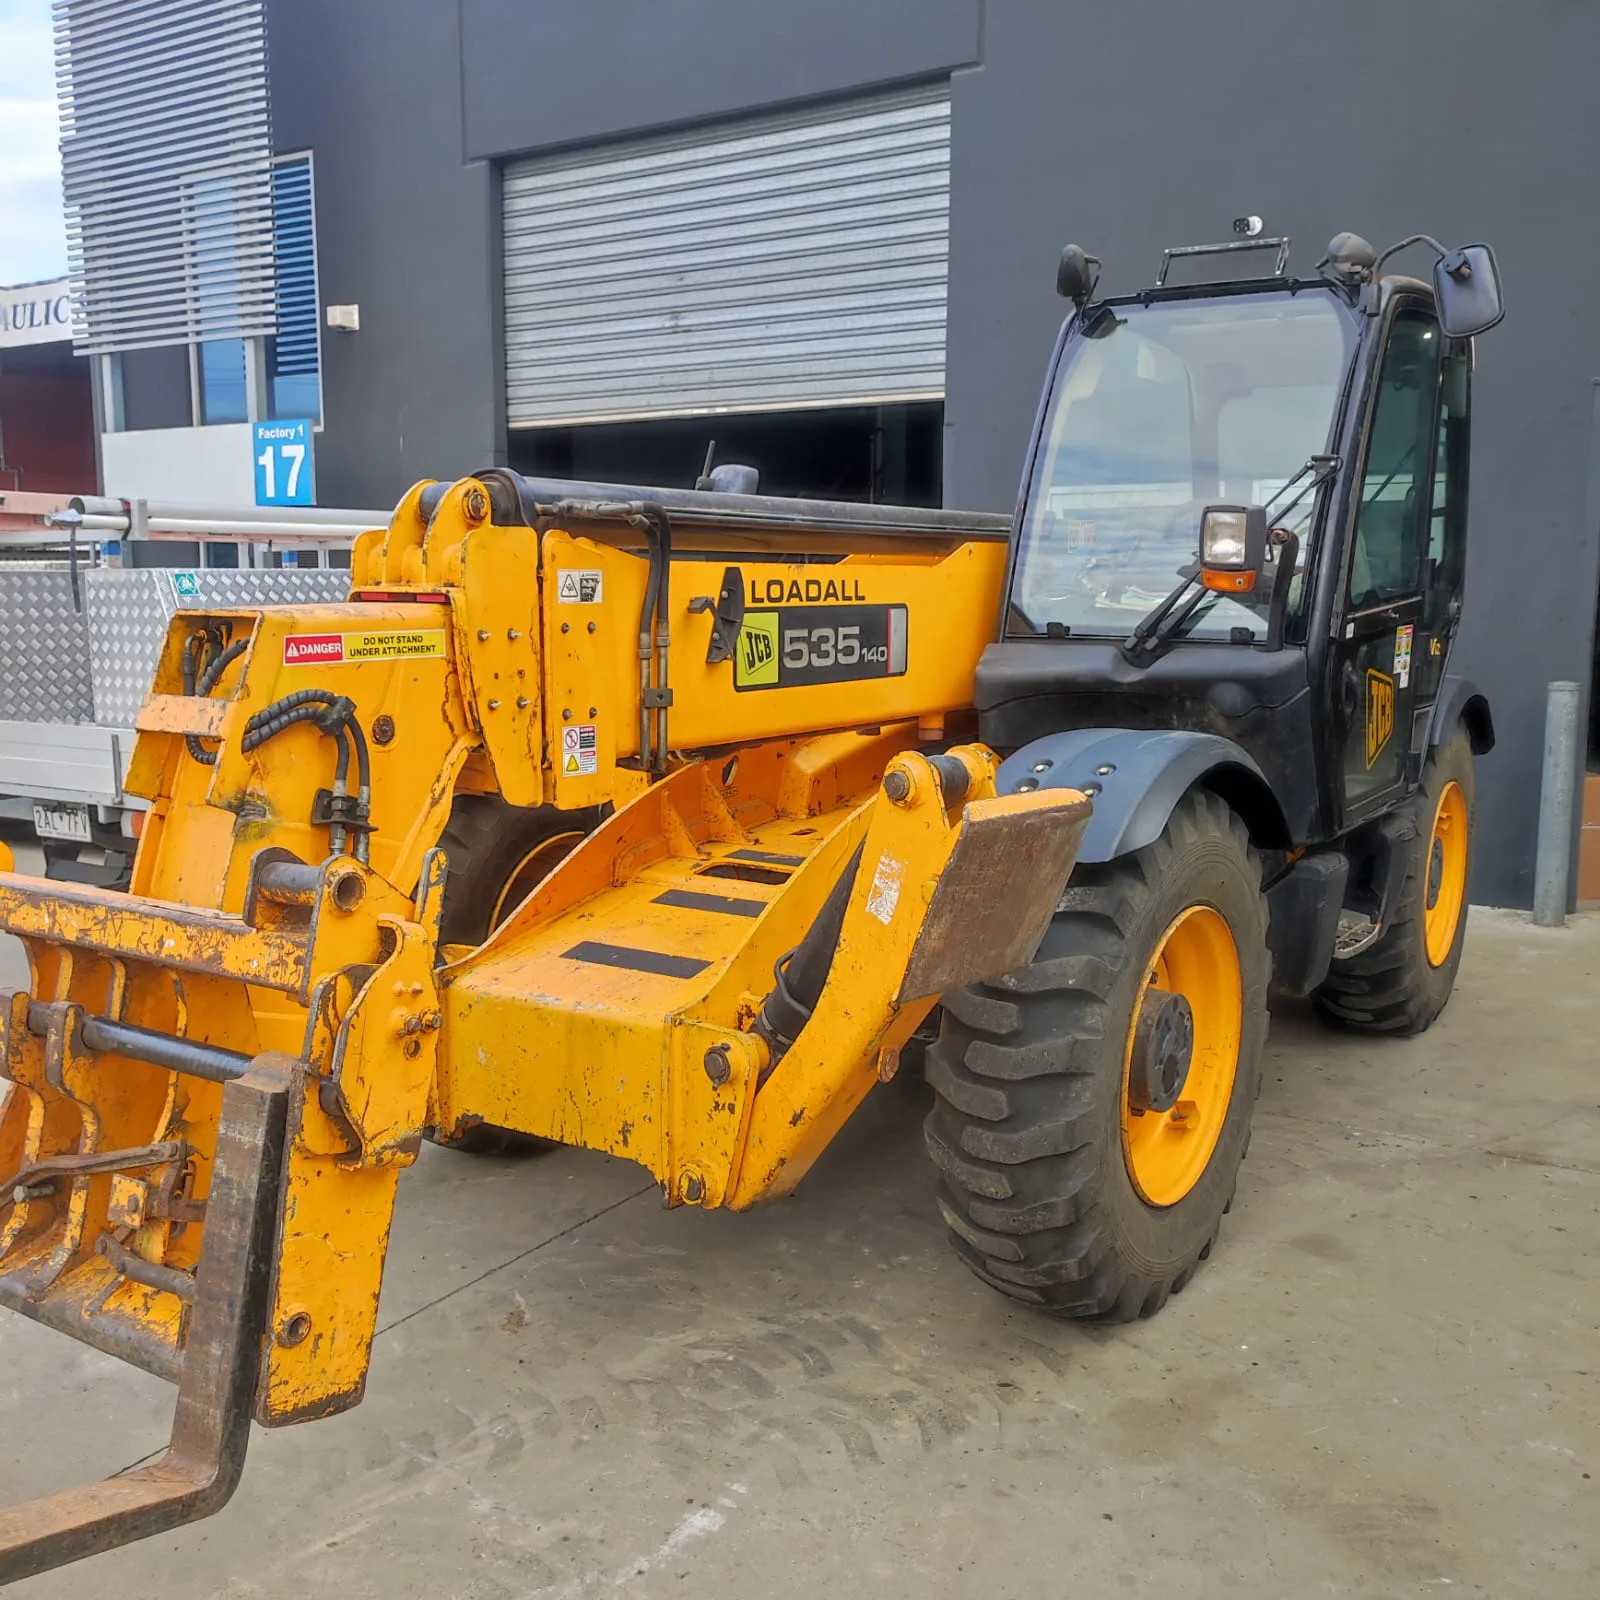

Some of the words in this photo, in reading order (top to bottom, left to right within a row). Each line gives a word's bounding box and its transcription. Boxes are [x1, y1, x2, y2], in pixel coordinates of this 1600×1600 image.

[258, 427, 295, 440] Factory
[297, 424, 304, 437] 1
[258, 444, 305, 498] 17
[751, 579, 866, 603] LOADALL
[299, 643, 342, 655] DANGER
[350, 648, 380, 657] UNDER
[381, 645, 436, 656] ATTACHMENT
[363, 637, 376, 645] DO
[377, 637, 395, 645] NOT
[396, 635, 424, 644] STAND
[746, 631, 772, 669] JCB
[783, 626, 860, 669] 535
[861, 646, 888, 663] 140
[1368, 679, 1392, 758] JCB
